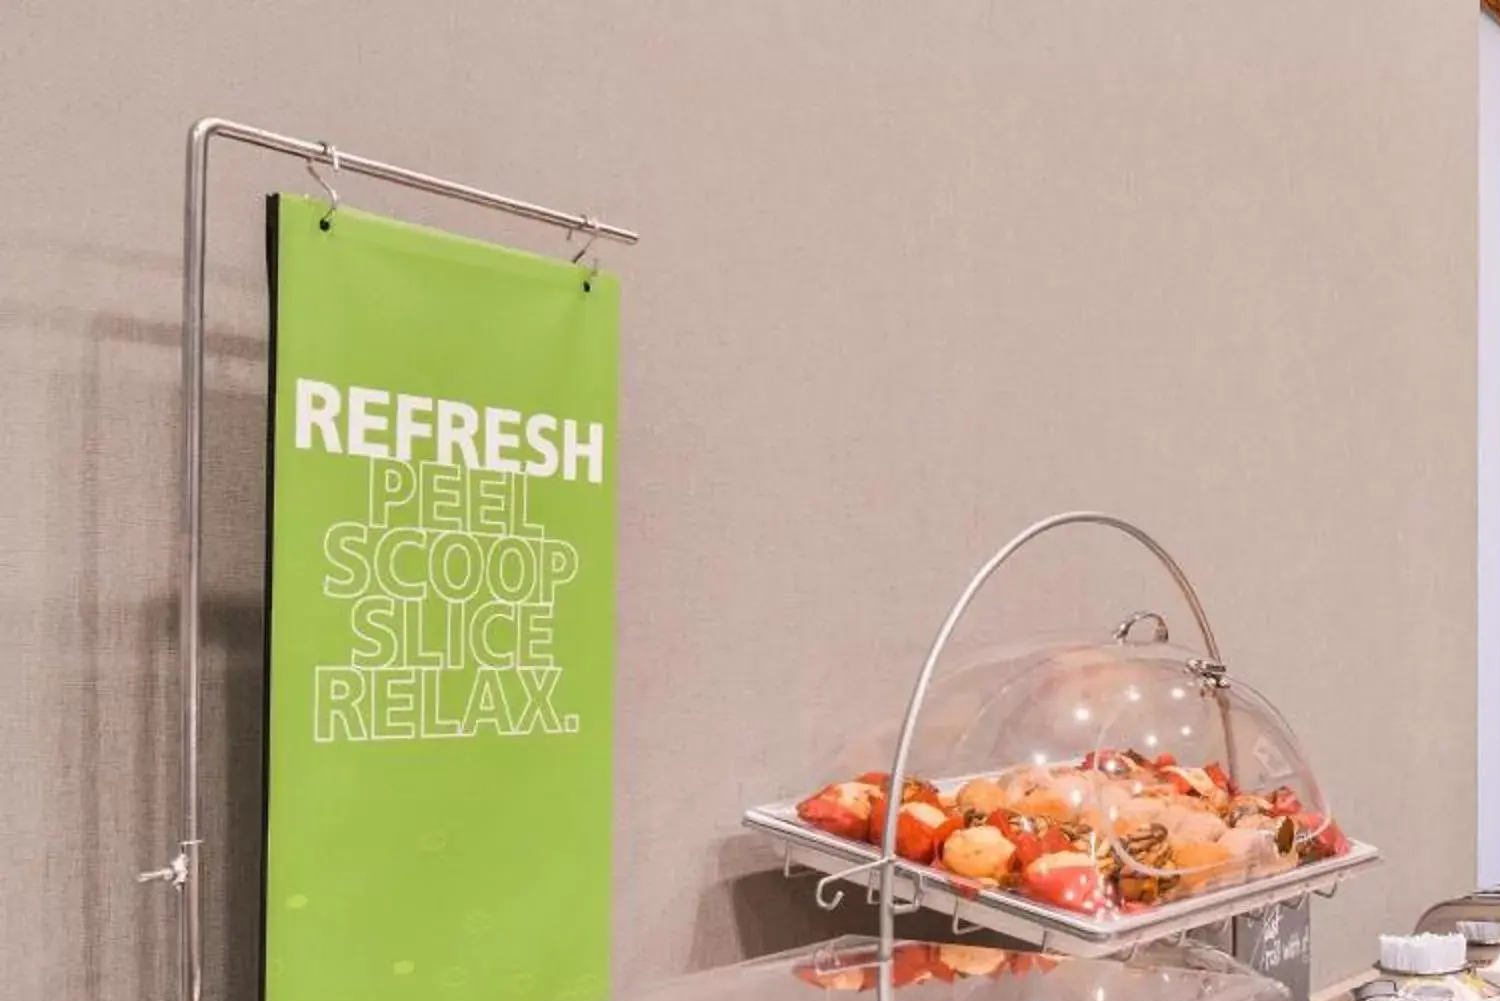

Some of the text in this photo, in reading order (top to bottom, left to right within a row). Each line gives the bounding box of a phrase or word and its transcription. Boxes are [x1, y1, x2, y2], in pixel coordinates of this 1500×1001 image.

[295, 378, 604, 483] REFRESH
[368, 457, 545, 541] PEEL
[323, 522, 580, 606] SCOOP
[351, 596, 555, 670] SLICE
[314, 665, 580, 742] RELAX.
